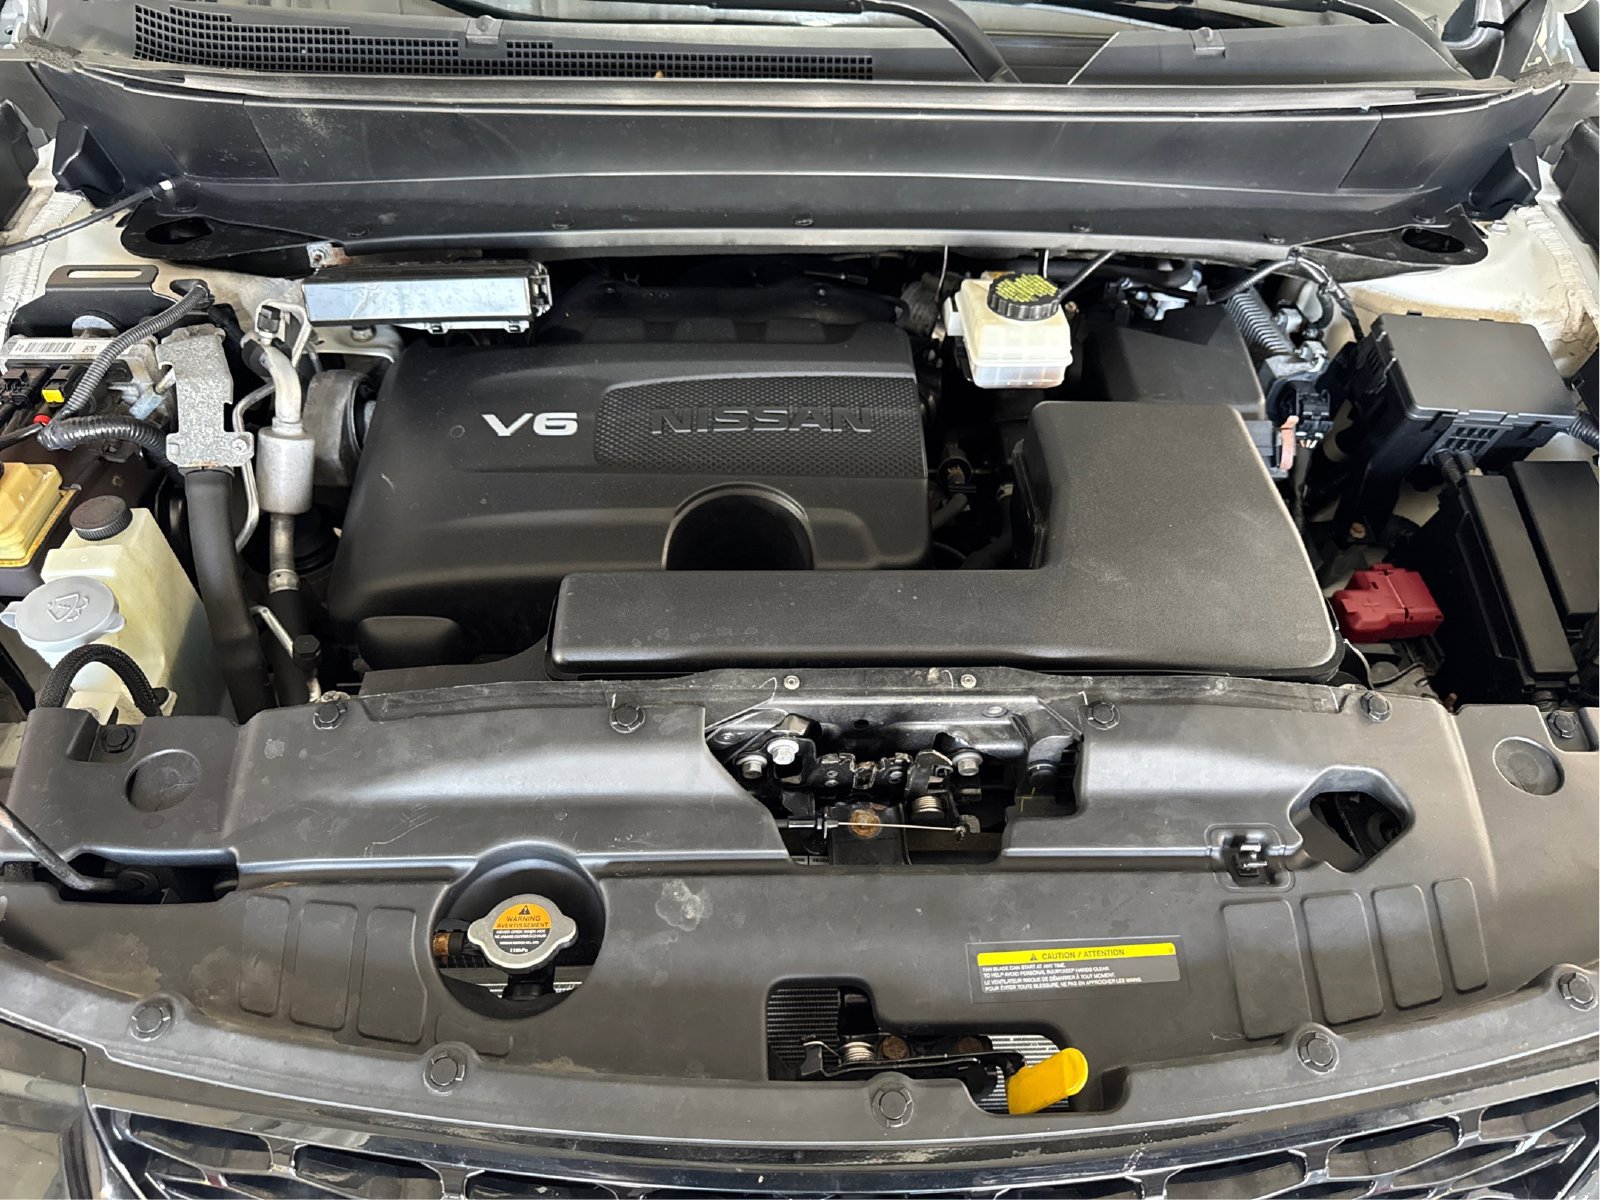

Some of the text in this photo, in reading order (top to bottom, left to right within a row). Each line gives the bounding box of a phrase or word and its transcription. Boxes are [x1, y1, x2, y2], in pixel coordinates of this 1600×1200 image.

[482, 412, 578, 436] V6
[651, 406, 872, 434] NISSAN
[1084, 949, 1124, 958] ATTENTION
